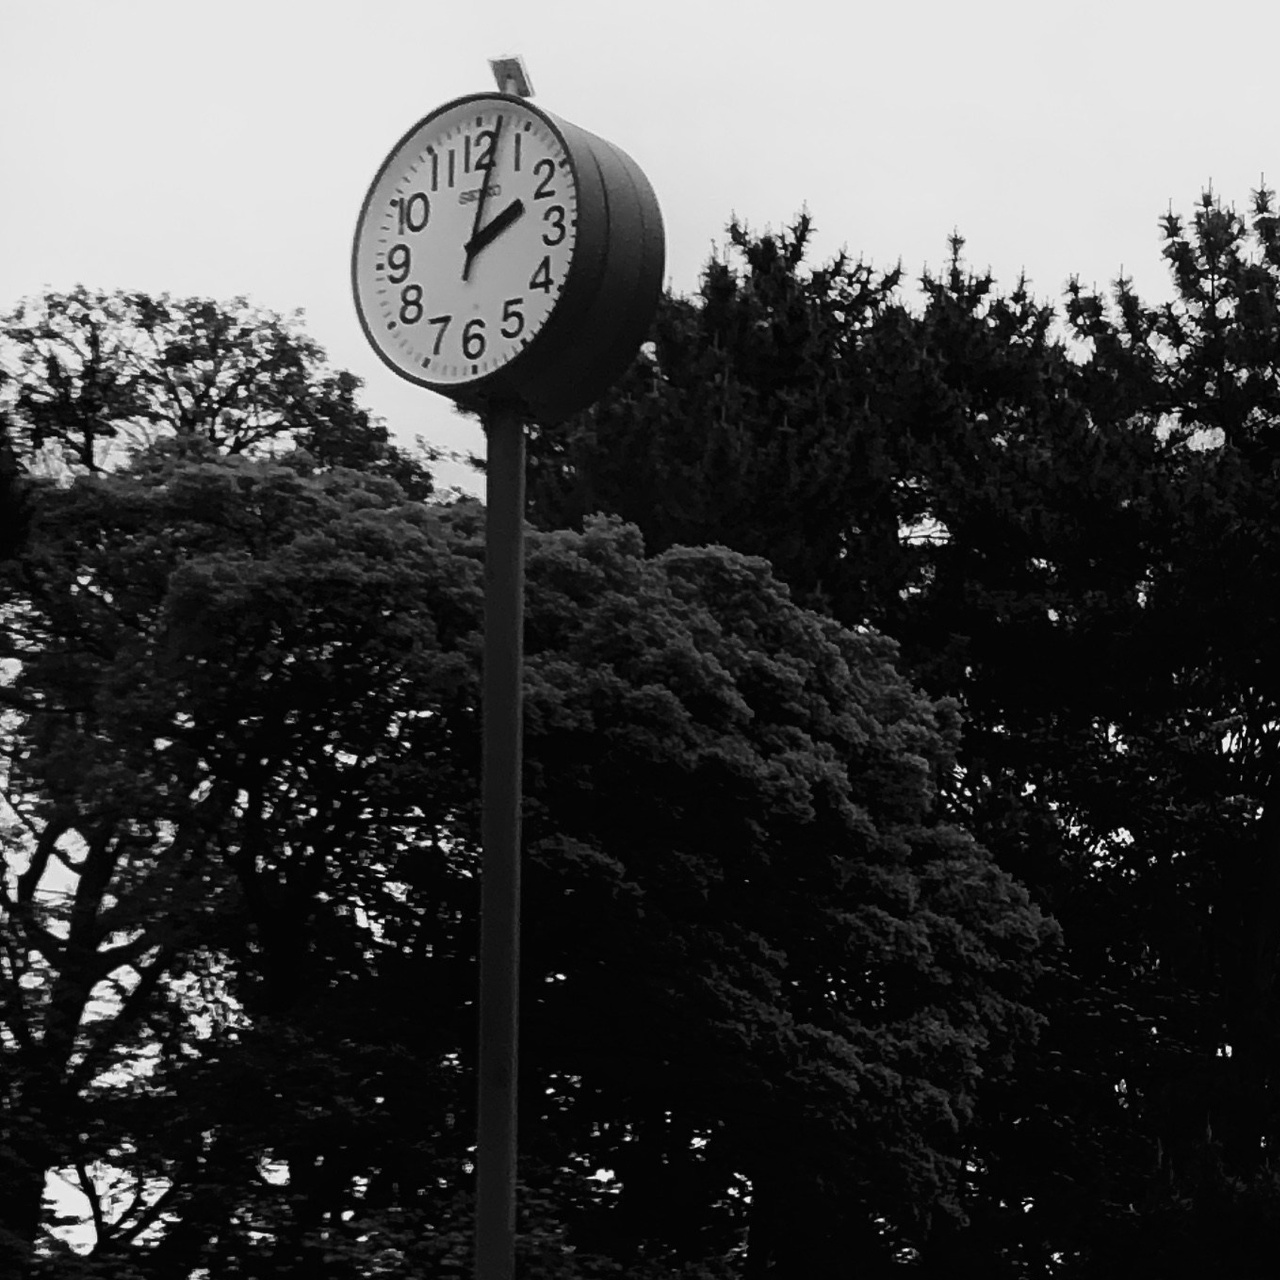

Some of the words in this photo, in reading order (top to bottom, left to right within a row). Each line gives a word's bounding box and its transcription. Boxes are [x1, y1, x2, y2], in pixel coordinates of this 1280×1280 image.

[430, 149, 455, 191] 11
[464, 130, 498, 173] 12
[514, 132, 521, 171] 1
[533, 158, 556, 200] 2
[397, 192, 430, 235] 10
[542, 205, 566, 246] 3
[387, 243, 411, 284] 9
[529, 255, 554, 294] 4
[399, 284, 423, 324] 8
[500, 297, 524, 339] 5
[427, 315, 452, 355] 7
[462, 319, 486, 360] 6
